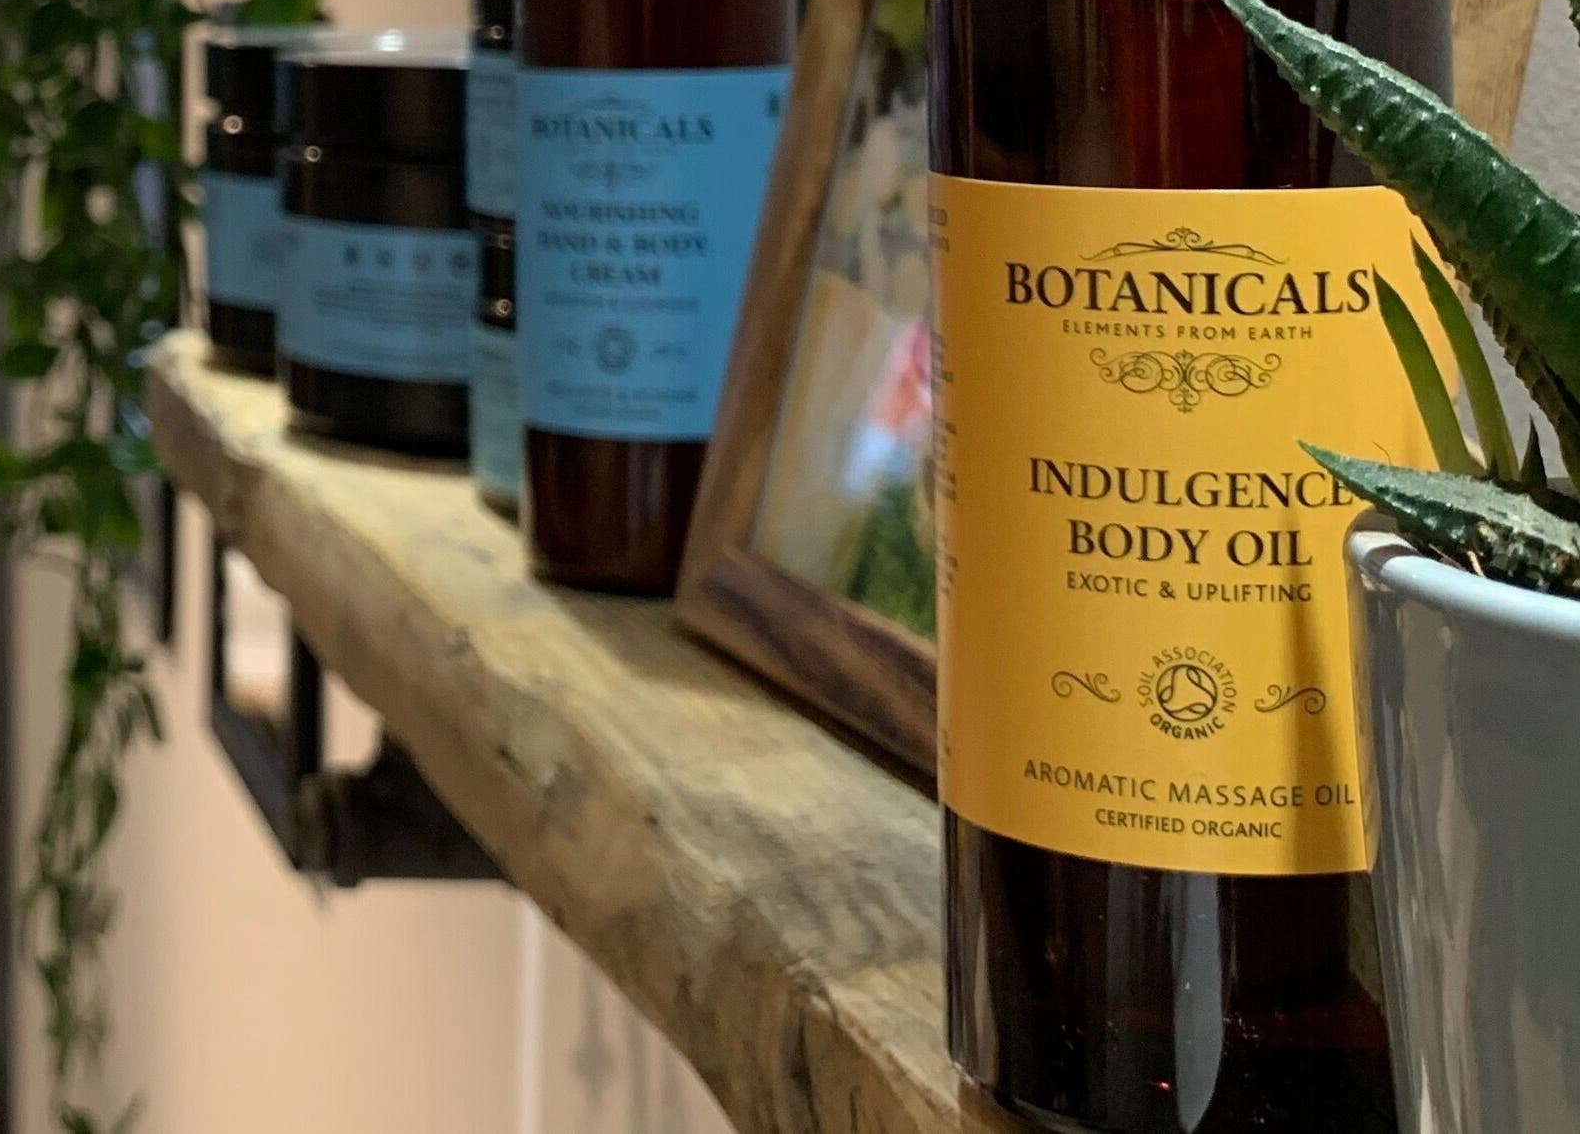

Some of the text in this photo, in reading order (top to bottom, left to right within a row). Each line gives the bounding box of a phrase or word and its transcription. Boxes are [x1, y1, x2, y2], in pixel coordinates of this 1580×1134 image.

[1006, 261, 1370, 316] BOTANICALS
[1062, 319, 1312, 341] ELEMENTS FROM EARTH
[1029, 457, 1353, 509] INDULGENCE
[1068, 519, 1313, 567] BODY OIL
[1067, 571, 1312, 603] EXOTIC & UPLIFTING
[1137, 646, 1237, 713] SOIL ASSOCIATION
[1149, 712, 1225, 740] ORGANIC
[1024, 759, 1356, 808] AROMATIC MASSAGE OIL
[1095, 808, 1282, 839] CERTIFIED ORGANIC
